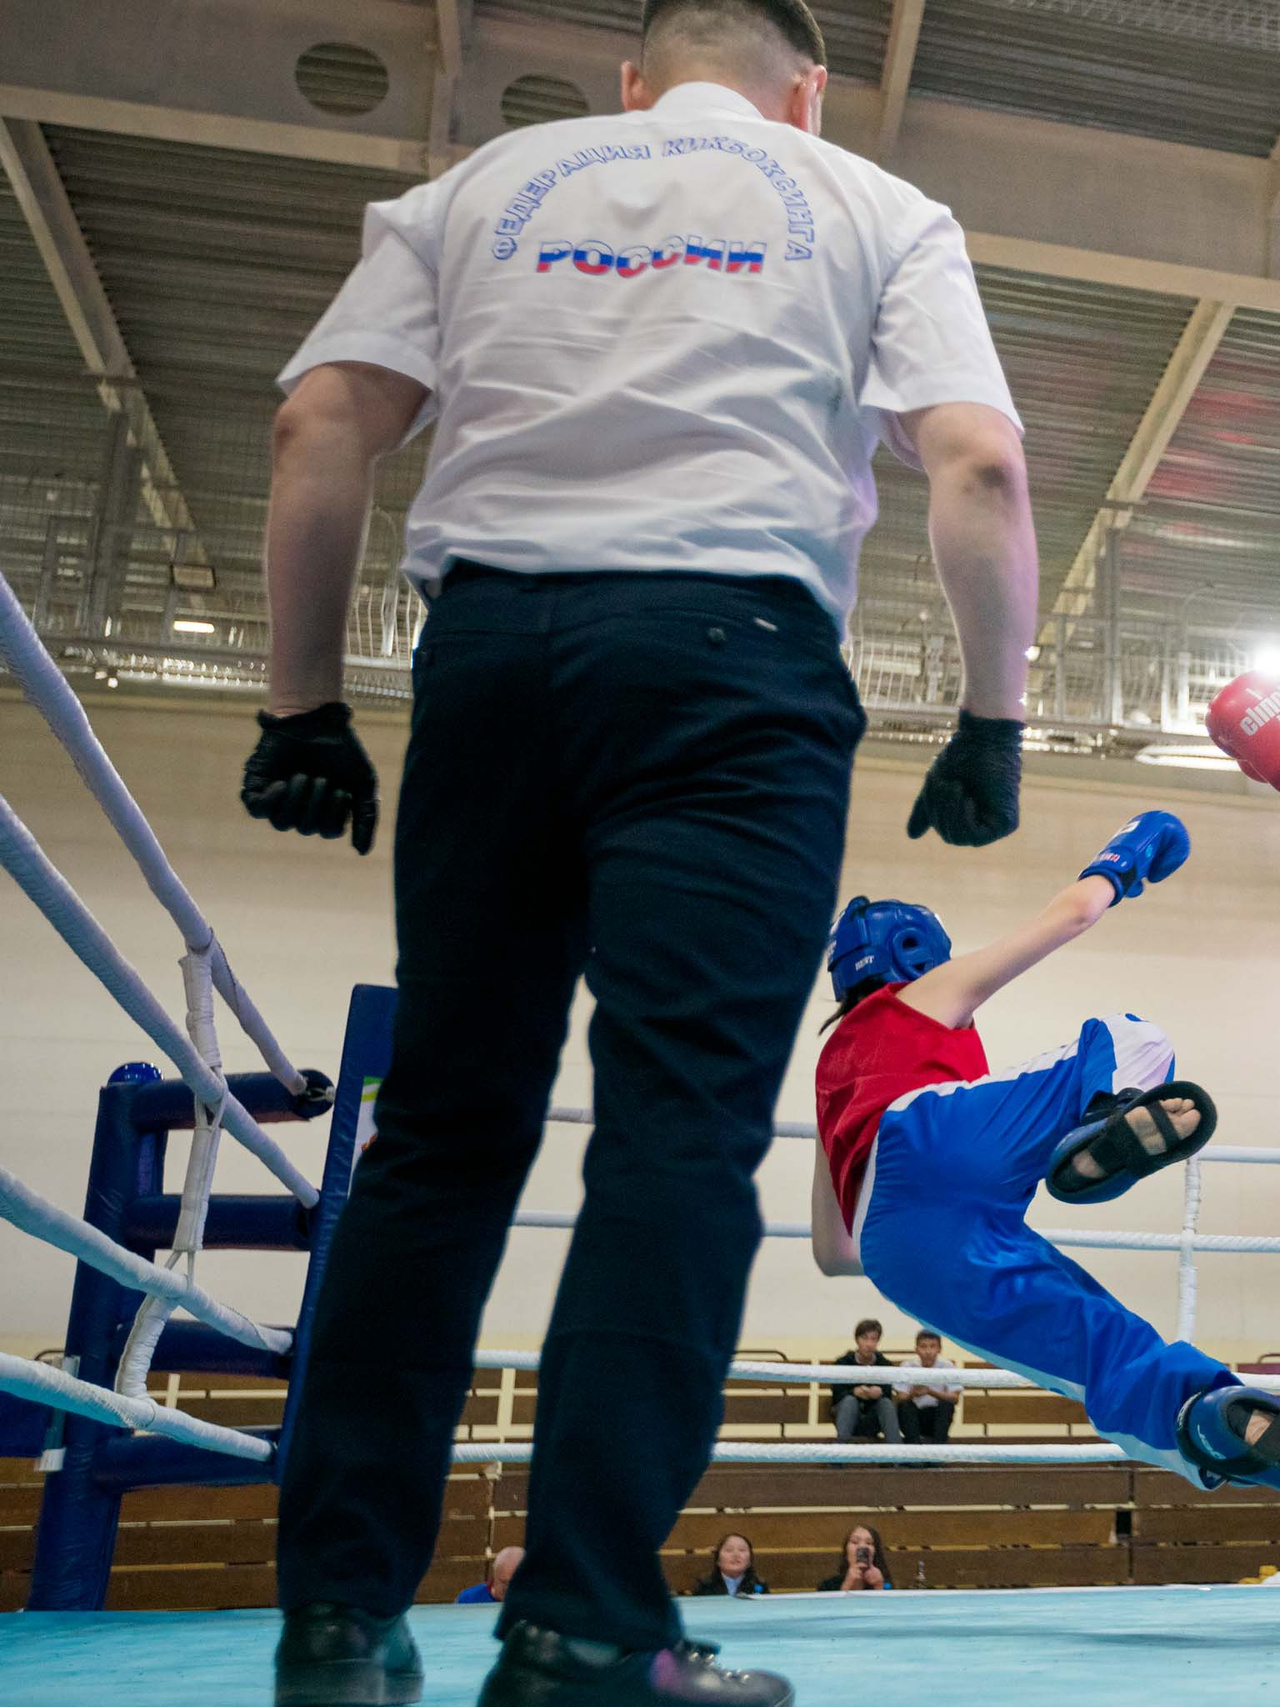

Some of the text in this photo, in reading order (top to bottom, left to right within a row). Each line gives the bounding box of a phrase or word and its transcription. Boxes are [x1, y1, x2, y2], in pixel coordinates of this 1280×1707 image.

[491, 136, 815, 261] ФЕДЕРАЦИЯ КИКБОКСИНГА
[536, 234, 767, 278] РОССИИ
